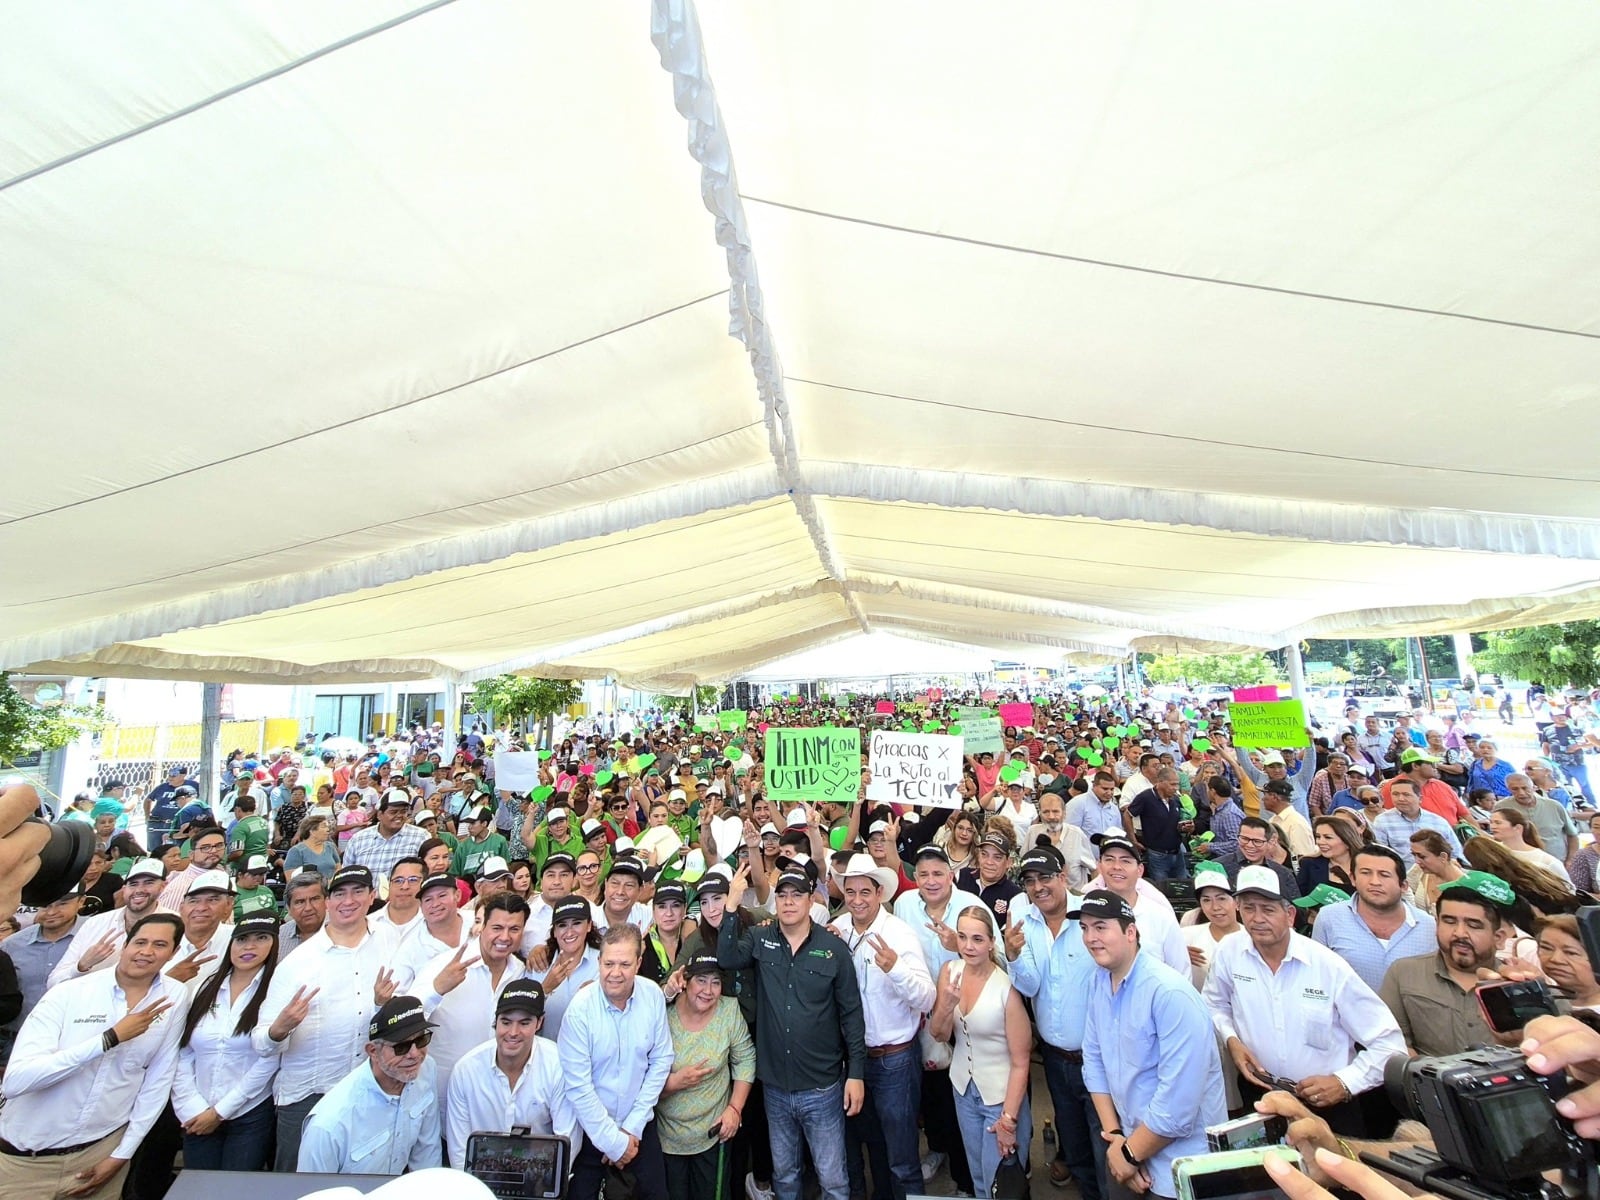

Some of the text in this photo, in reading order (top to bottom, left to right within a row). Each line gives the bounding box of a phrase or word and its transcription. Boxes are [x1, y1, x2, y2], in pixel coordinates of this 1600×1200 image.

[1228, 705, 1267, 715] FAMILIA
[831, 737, 856, 754] CON
[874, 734, 929, 760] Gracias
[770, 768, 819, 789] USTED
[874, 762, 891, 778] La
[938, 766, 950, 781] al
